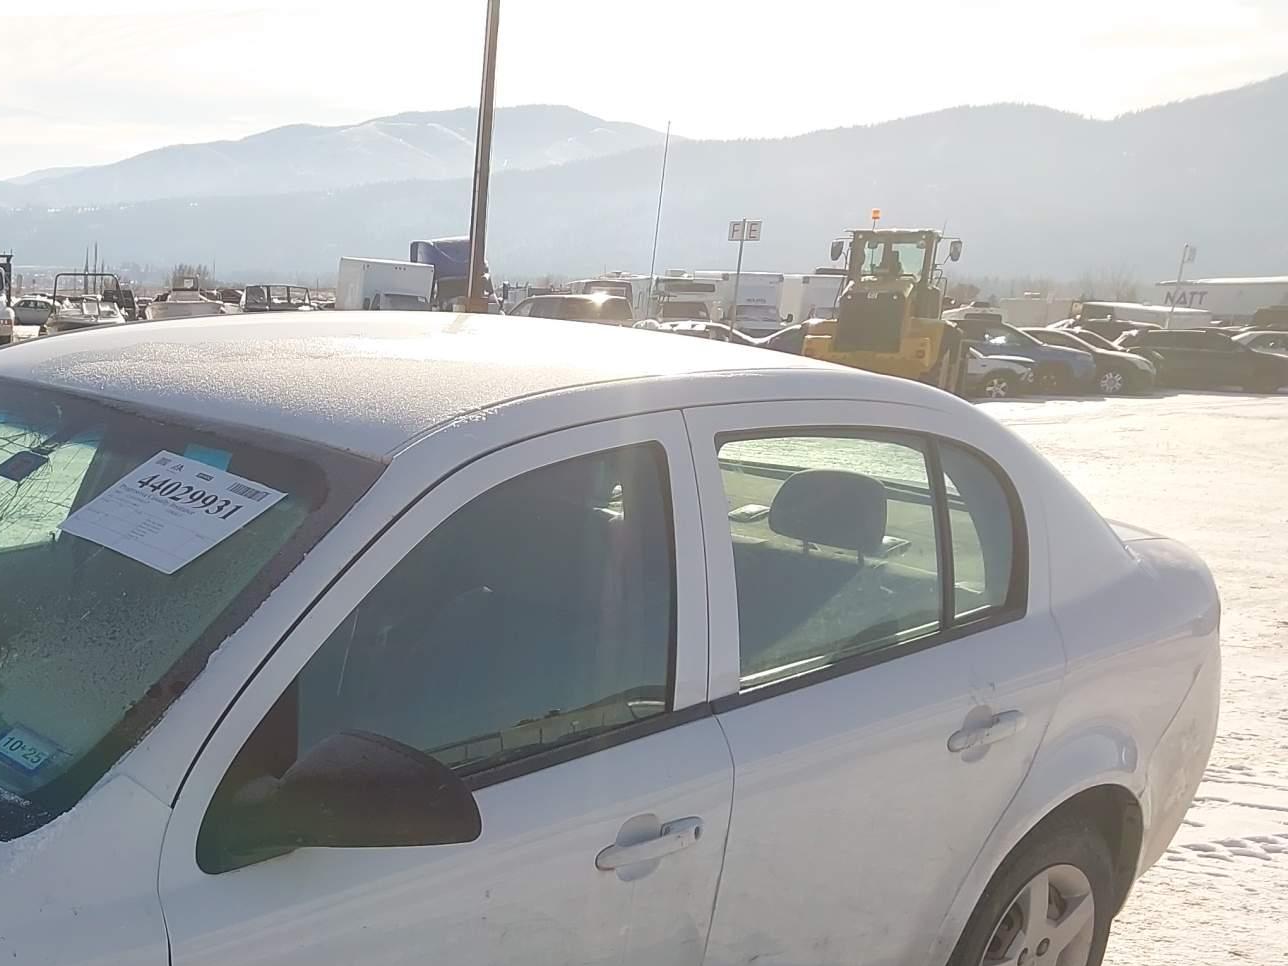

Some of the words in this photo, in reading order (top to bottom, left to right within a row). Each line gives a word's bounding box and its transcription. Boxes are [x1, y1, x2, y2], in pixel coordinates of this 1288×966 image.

[732, 223, 741, 239] F
[748, 223, 759, 239] E
[137, 474, 244, 520] 44029931
